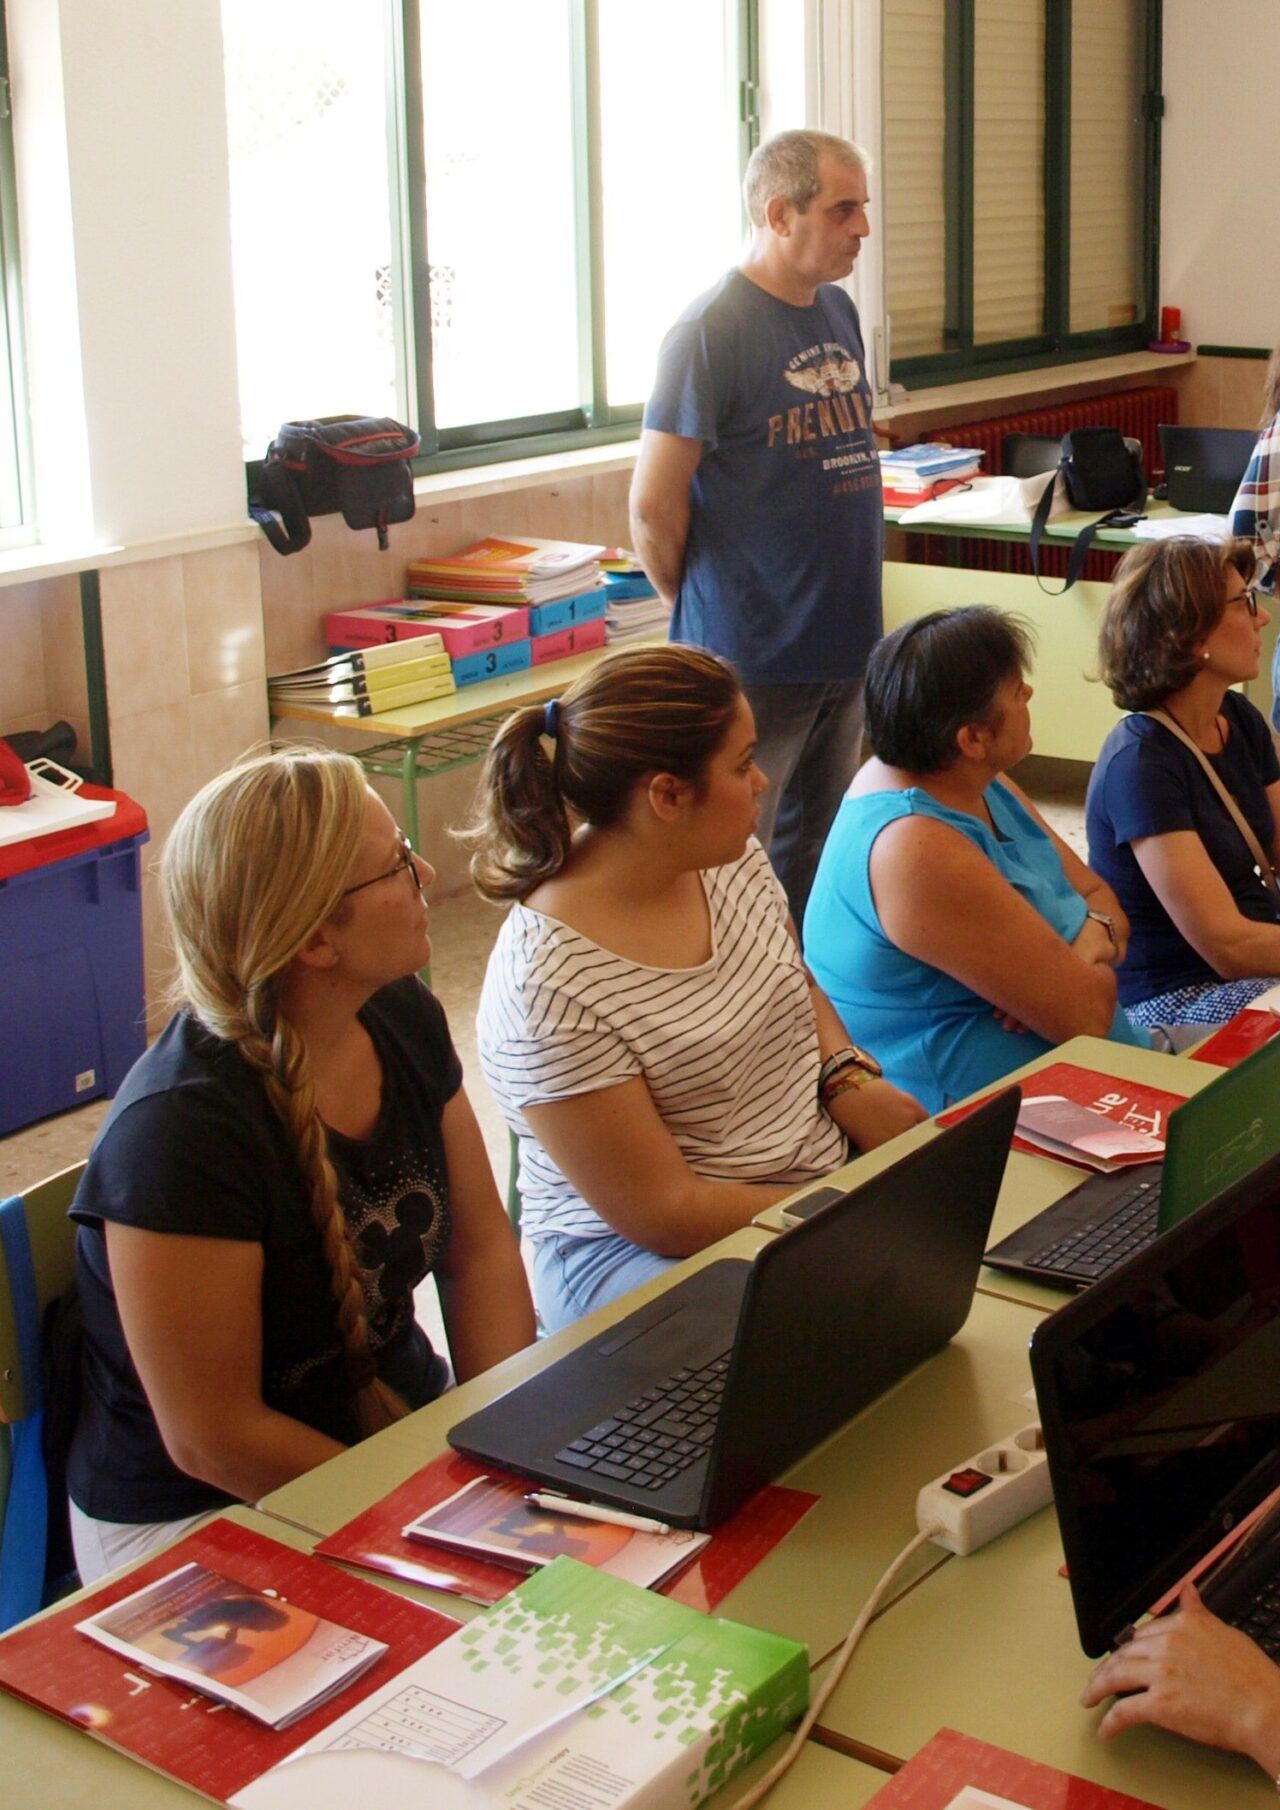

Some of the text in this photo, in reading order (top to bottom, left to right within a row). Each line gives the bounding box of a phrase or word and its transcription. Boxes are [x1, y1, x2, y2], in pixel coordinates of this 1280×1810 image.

[385, 624, 397, 643] 3
[492, 621, 504, 642] 3
[485, 653, 497, 673] 3
